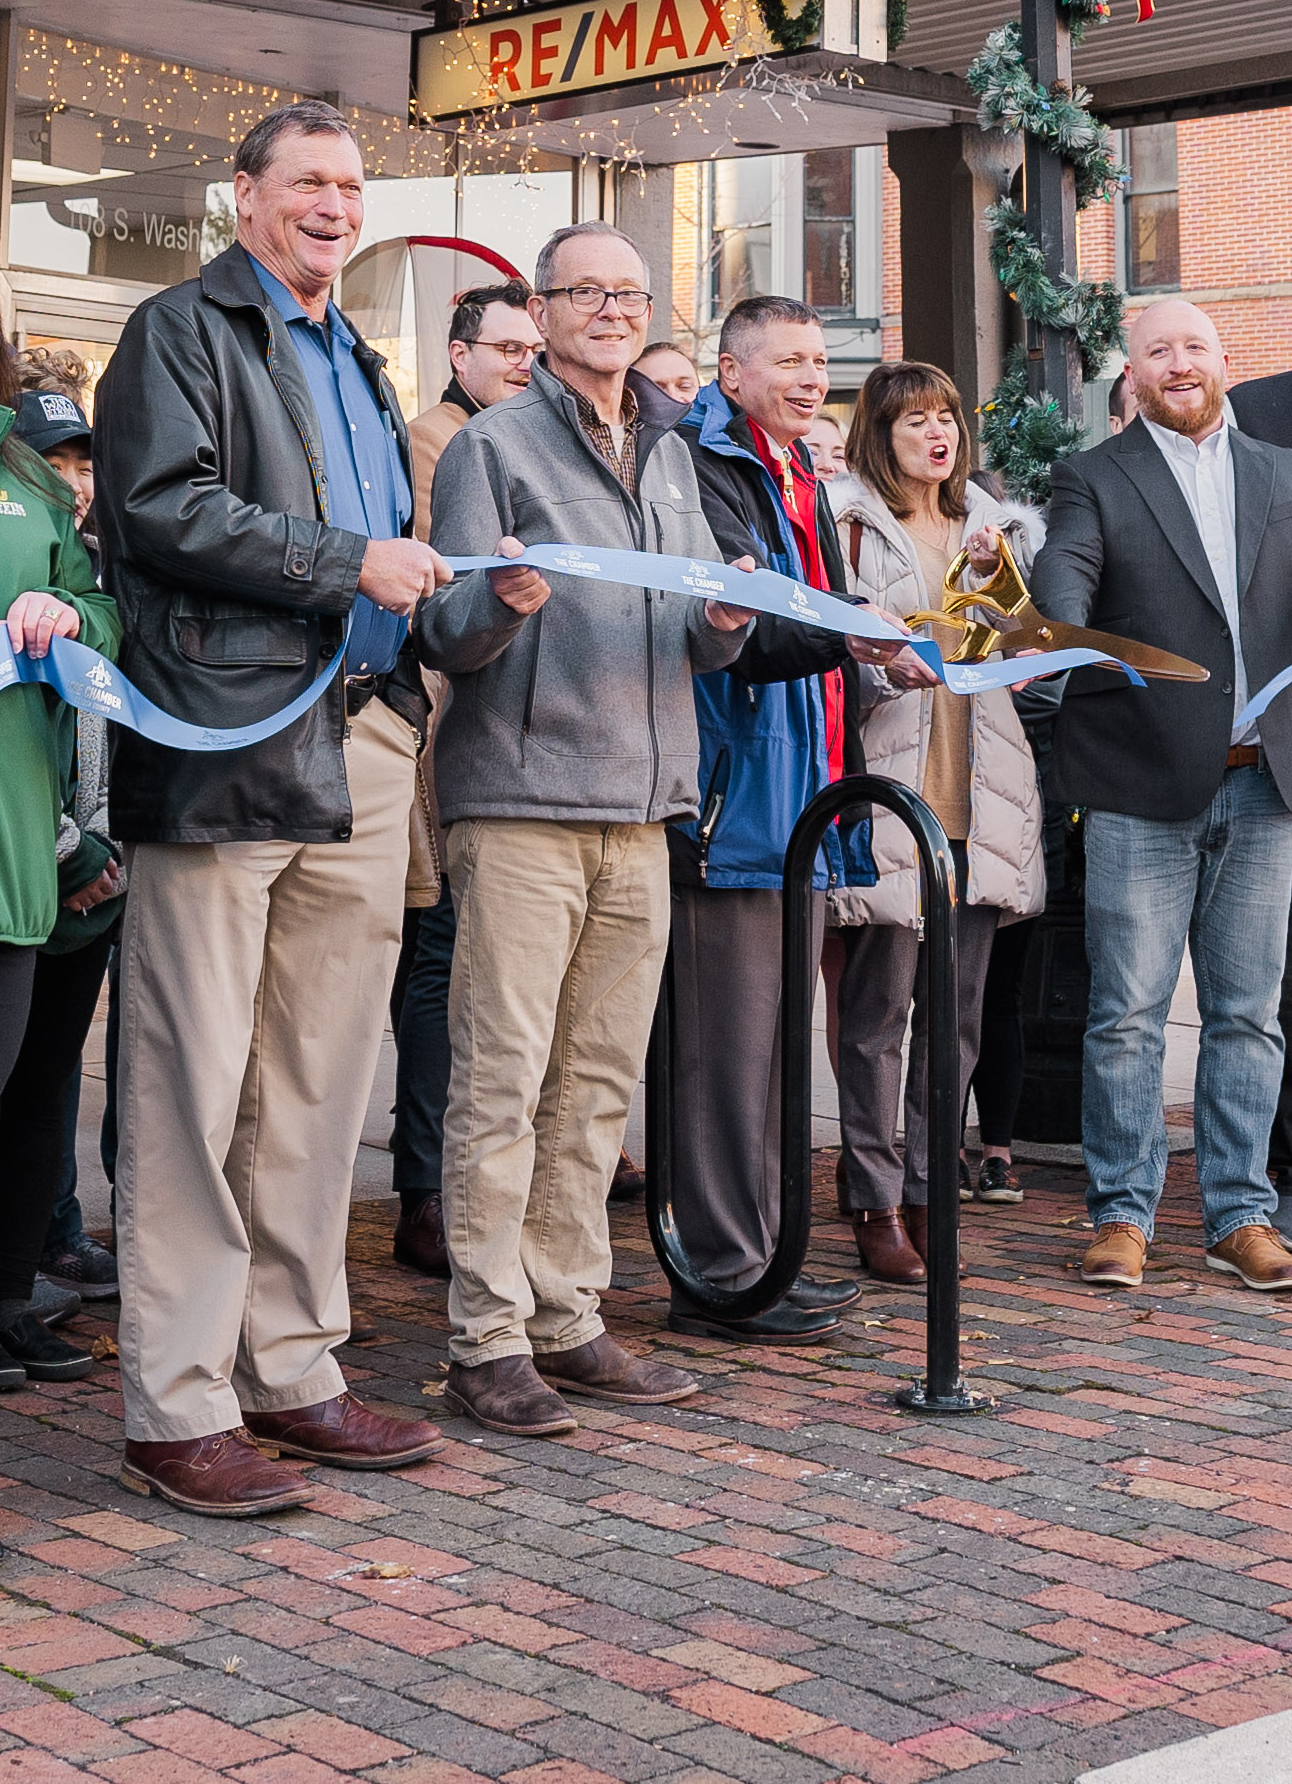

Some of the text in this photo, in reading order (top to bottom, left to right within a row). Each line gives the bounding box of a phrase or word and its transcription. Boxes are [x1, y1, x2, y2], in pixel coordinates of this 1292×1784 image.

[113, 207, 135, 243] S.
[695, 577, 725, 591] CHAMBER
[84, 686, 122, 710] CHAMBER
